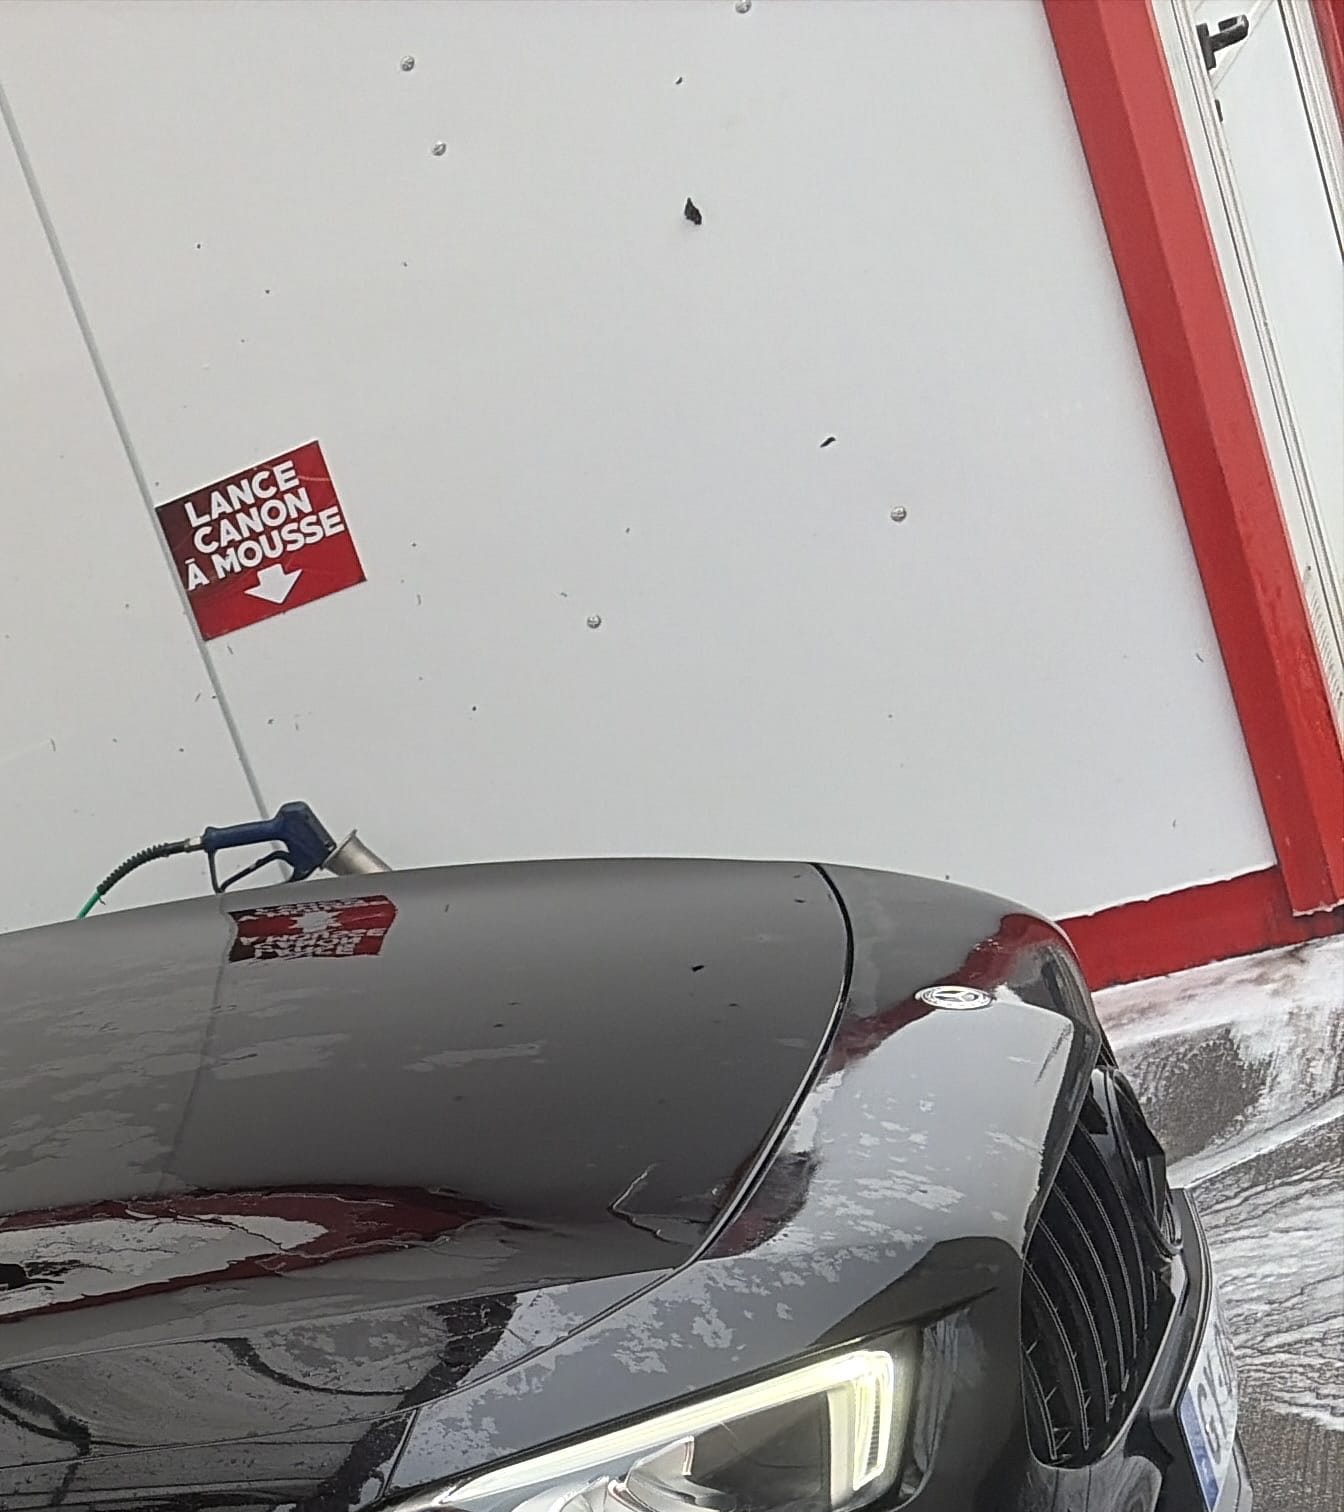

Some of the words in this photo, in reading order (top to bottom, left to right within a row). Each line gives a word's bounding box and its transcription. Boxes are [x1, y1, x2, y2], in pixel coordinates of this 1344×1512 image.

[184, 460, 300, 528] LANCE
[193, 487, 313, 554] CANON
[215, 505, 345, 580] MOUSSE
